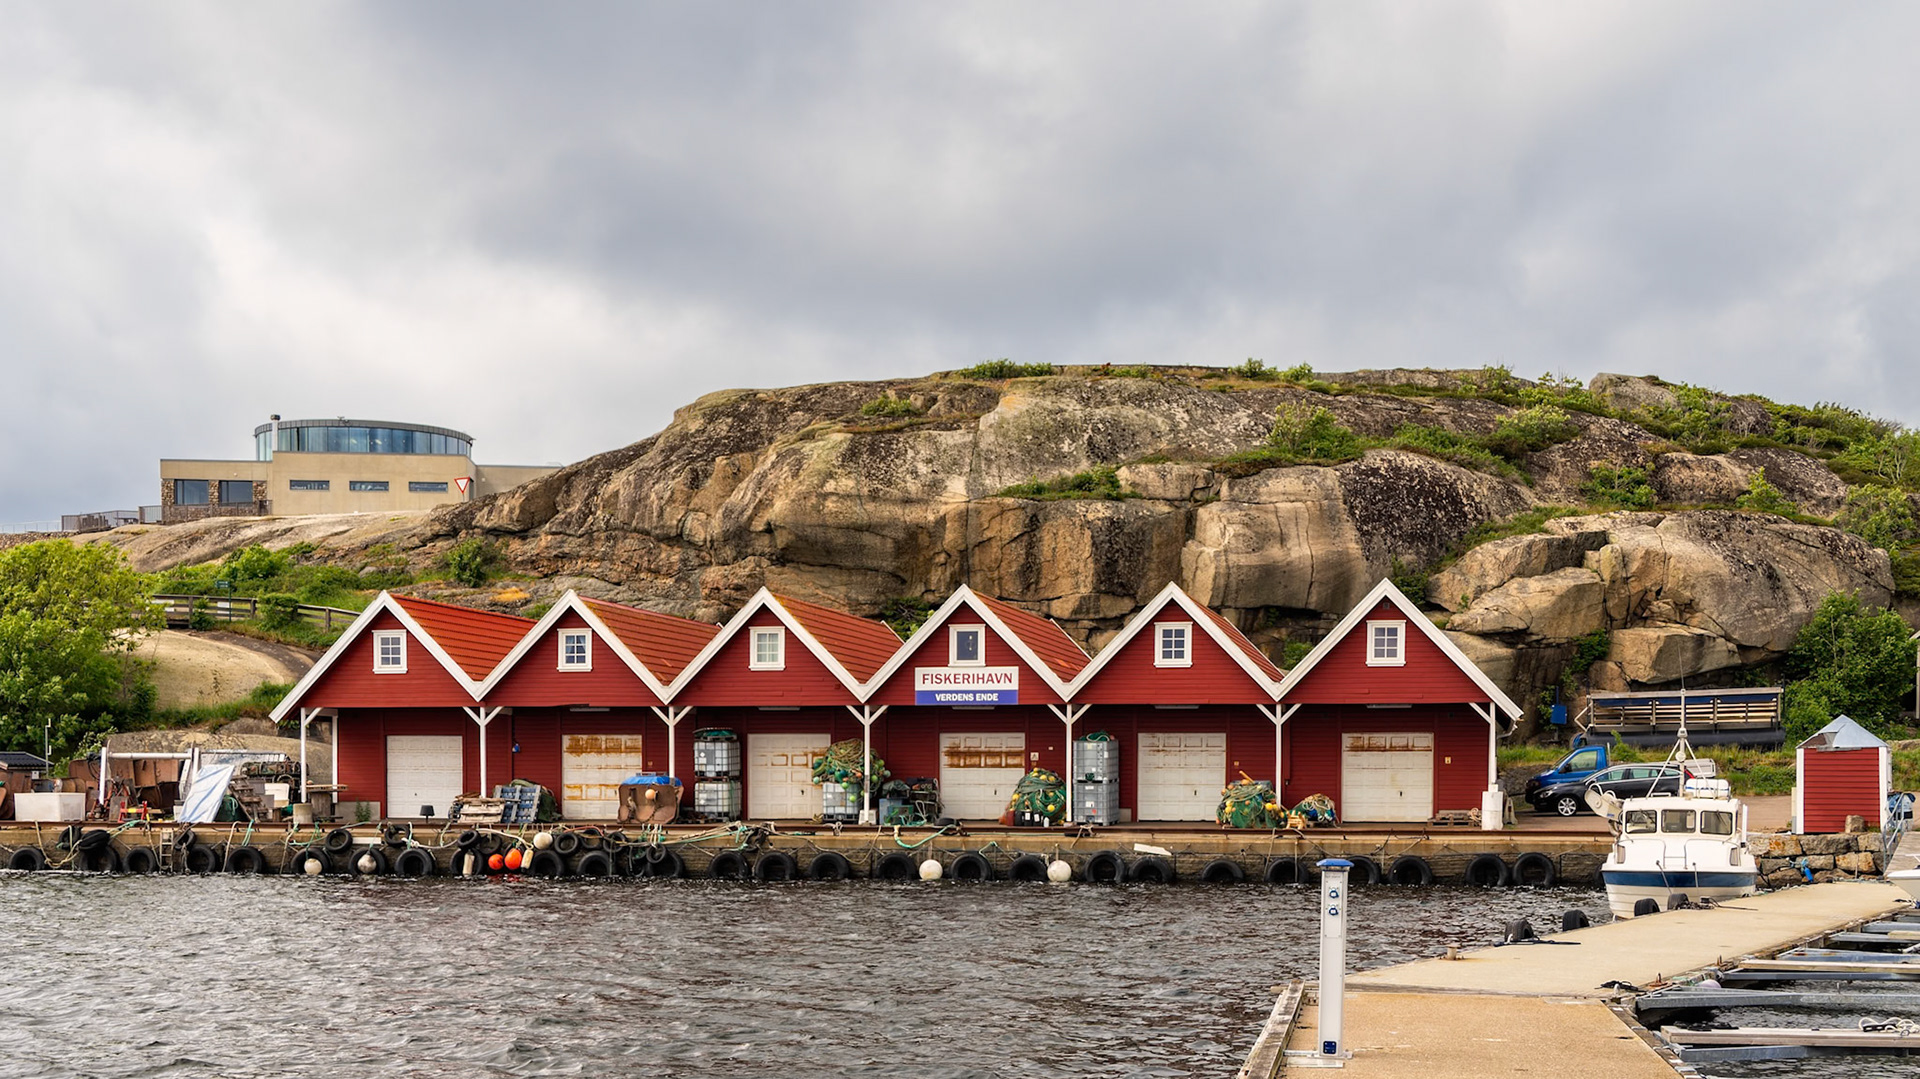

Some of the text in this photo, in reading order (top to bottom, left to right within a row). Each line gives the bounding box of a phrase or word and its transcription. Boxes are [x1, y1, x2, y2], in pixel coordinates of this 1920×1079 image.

[922, 673, 1013, 684] FISKERIHAVN
[935, 693, 999, 702] VERDENS ENDE
